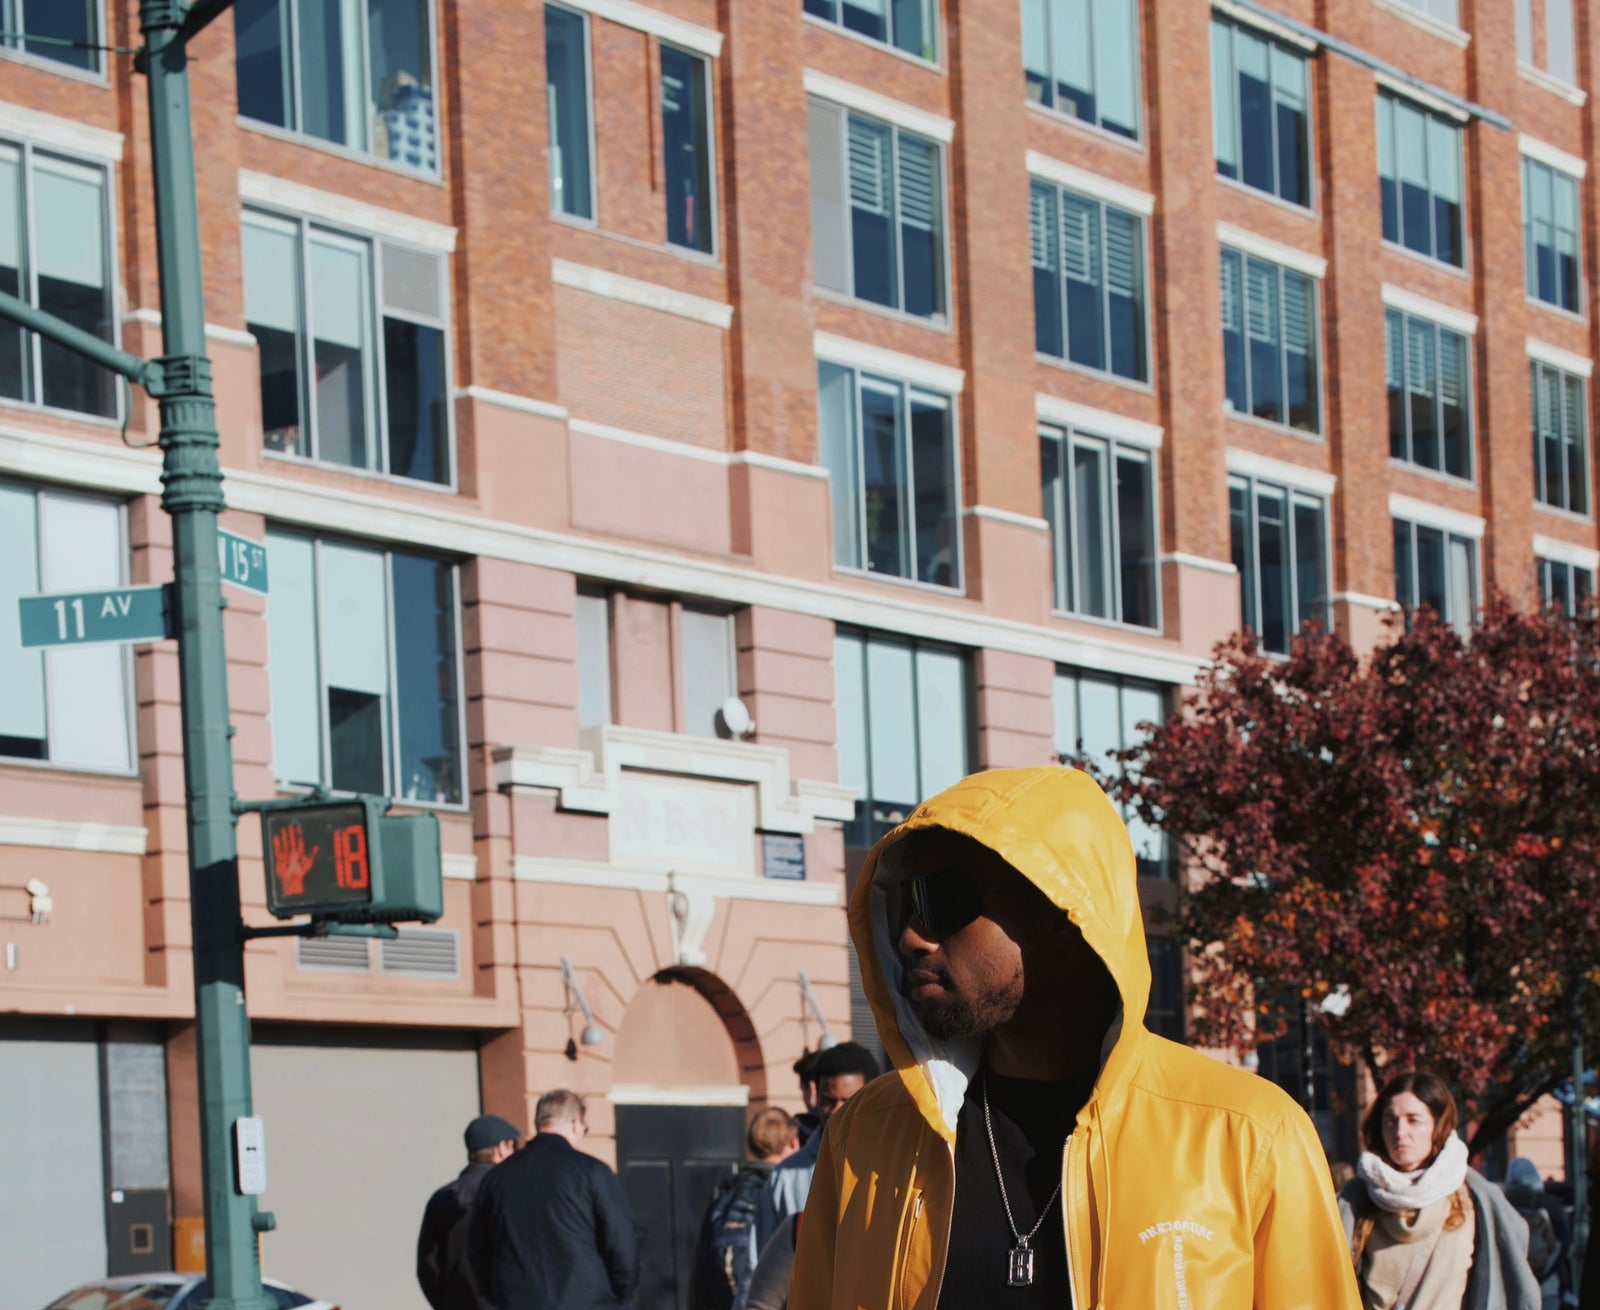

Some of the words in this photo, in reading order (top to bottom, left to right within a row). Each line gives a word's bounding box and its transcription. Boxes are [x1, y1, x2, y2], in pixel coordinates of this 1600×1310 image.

[232, 540, 249, 582] 15
[54, 599, 85, 640] 11
[101, 595, 132, 618] AV
[333, 824, 369, 890] 18
